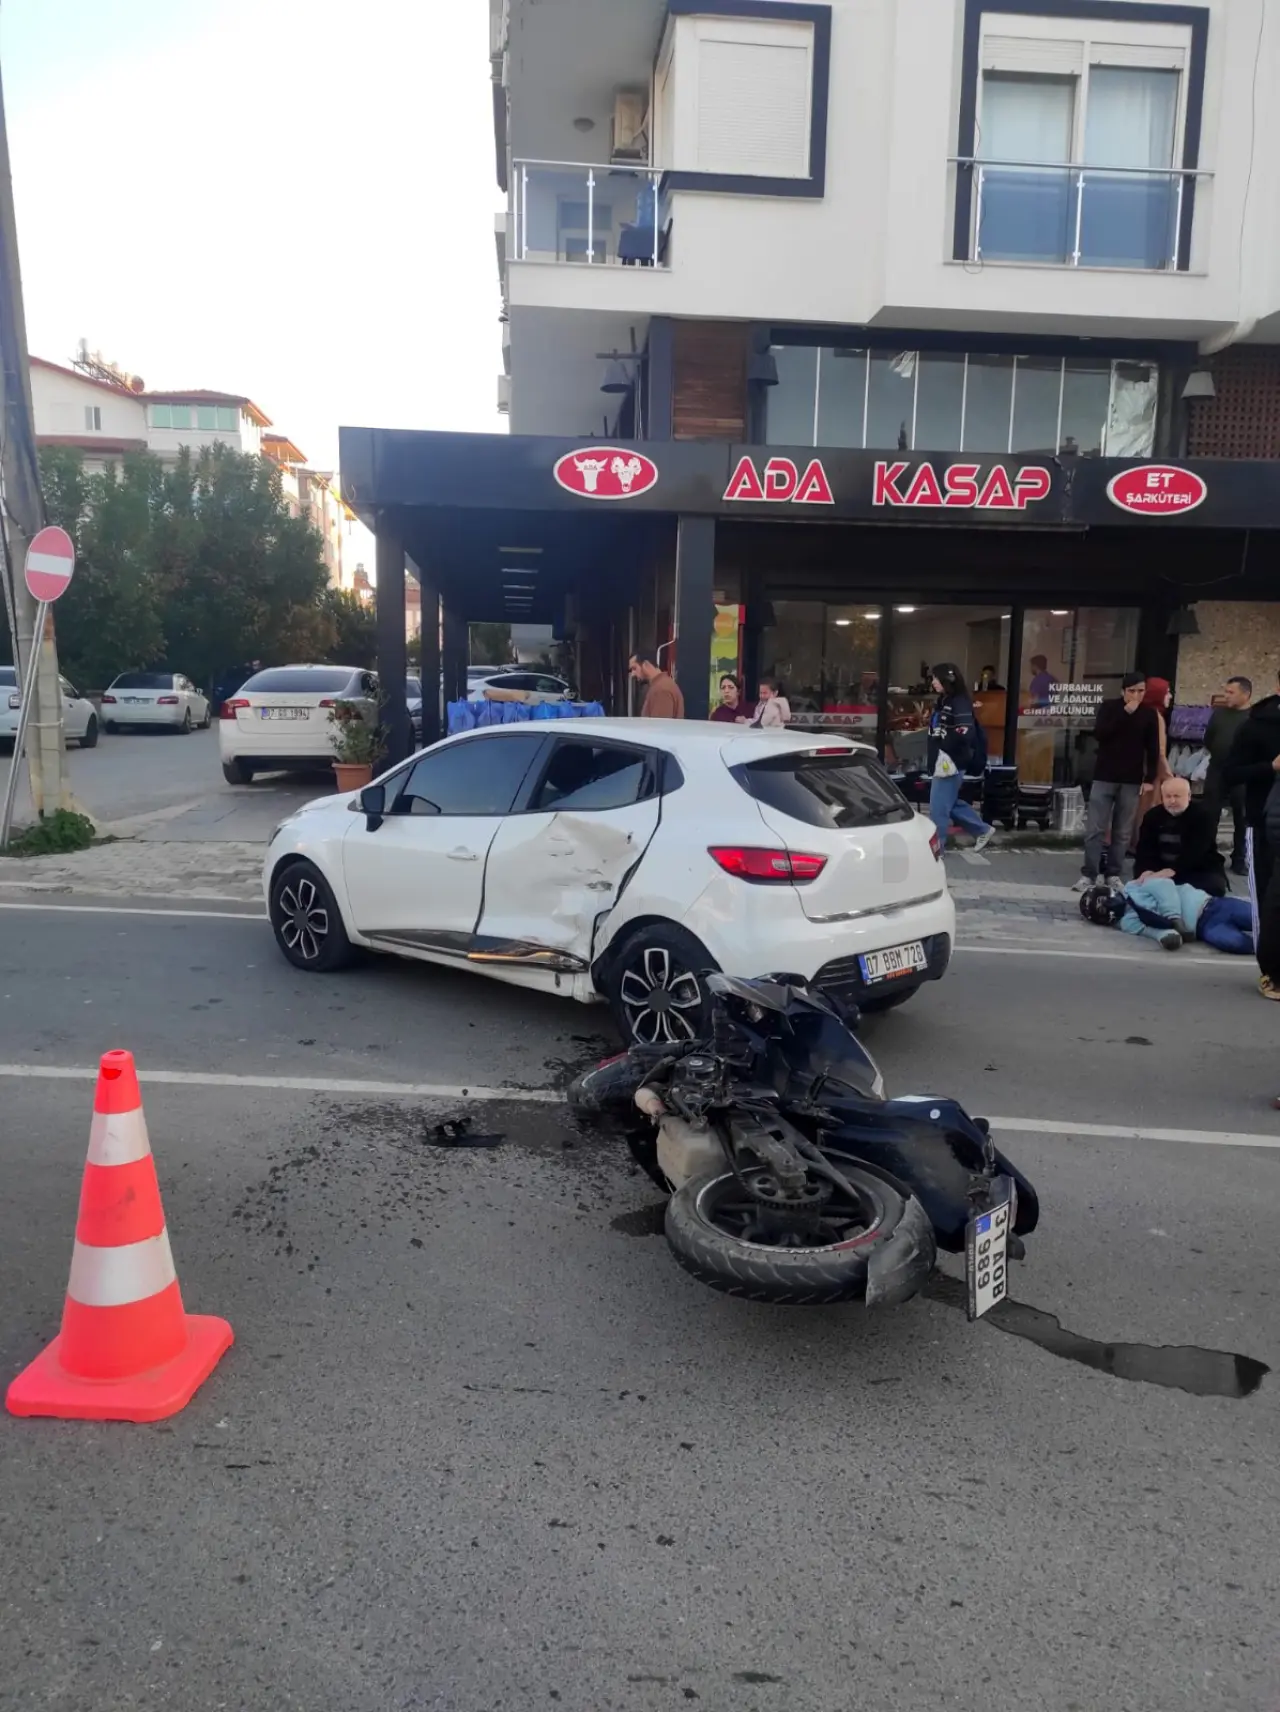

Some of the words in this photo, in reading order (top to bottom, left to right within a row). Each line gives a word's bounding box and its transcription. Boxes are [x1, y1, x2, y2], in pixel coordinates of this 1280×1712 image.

[722, 455, 835, 505] ADA
[872, 461, 1051, 510] KASAP
[1146, 472, 1176, 488] ET
[1126, 491, 1192, 505] ŞARKÜTERİ
[1048, 683, 1104, 693] KURBANLIK
[1048, 694, 1060, 704] VE
[1062, 695, 1104, 704] ADAKLIK
[1050, 705, 1096, 715] BULUNUR
[813, 715, 863, 725] KASAP
[866, 955, 879, 976] 07
[994, 1209, 1007, 1241] 31
[978, 1238, 991, 1290] 989
[992, 1251, 1005, 1298] AOB
